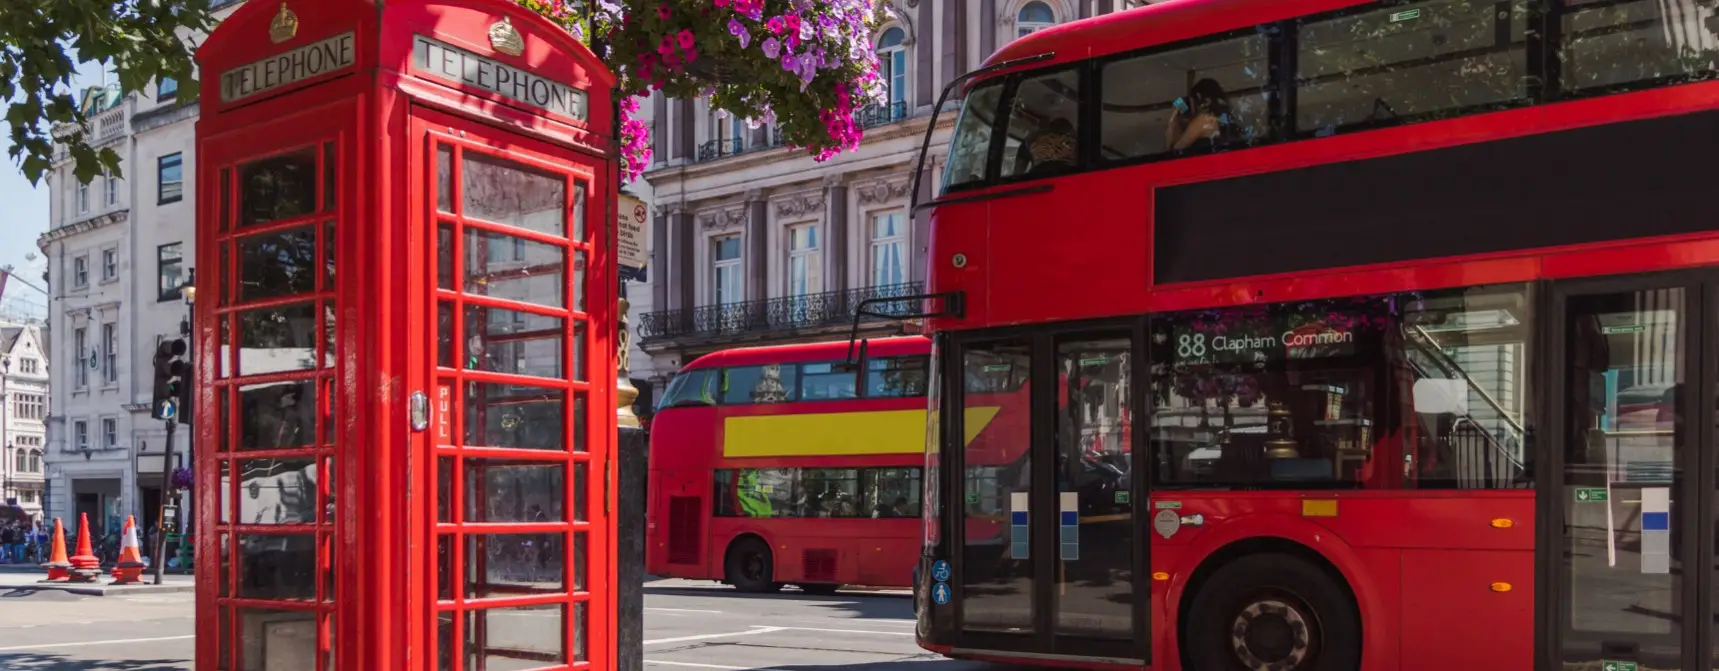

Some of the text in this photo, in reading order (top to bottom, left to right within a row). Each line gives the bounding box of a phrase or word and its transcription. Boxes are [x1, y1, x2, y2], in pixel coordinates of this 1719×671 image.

[223, 35, 352, 98] TELEPHONE
[418, 39, 582, 119] TELEPHONE
[1178, 330, 1353, 357] 88 Clapham Common
[440, 387, 448, 437] PULL
